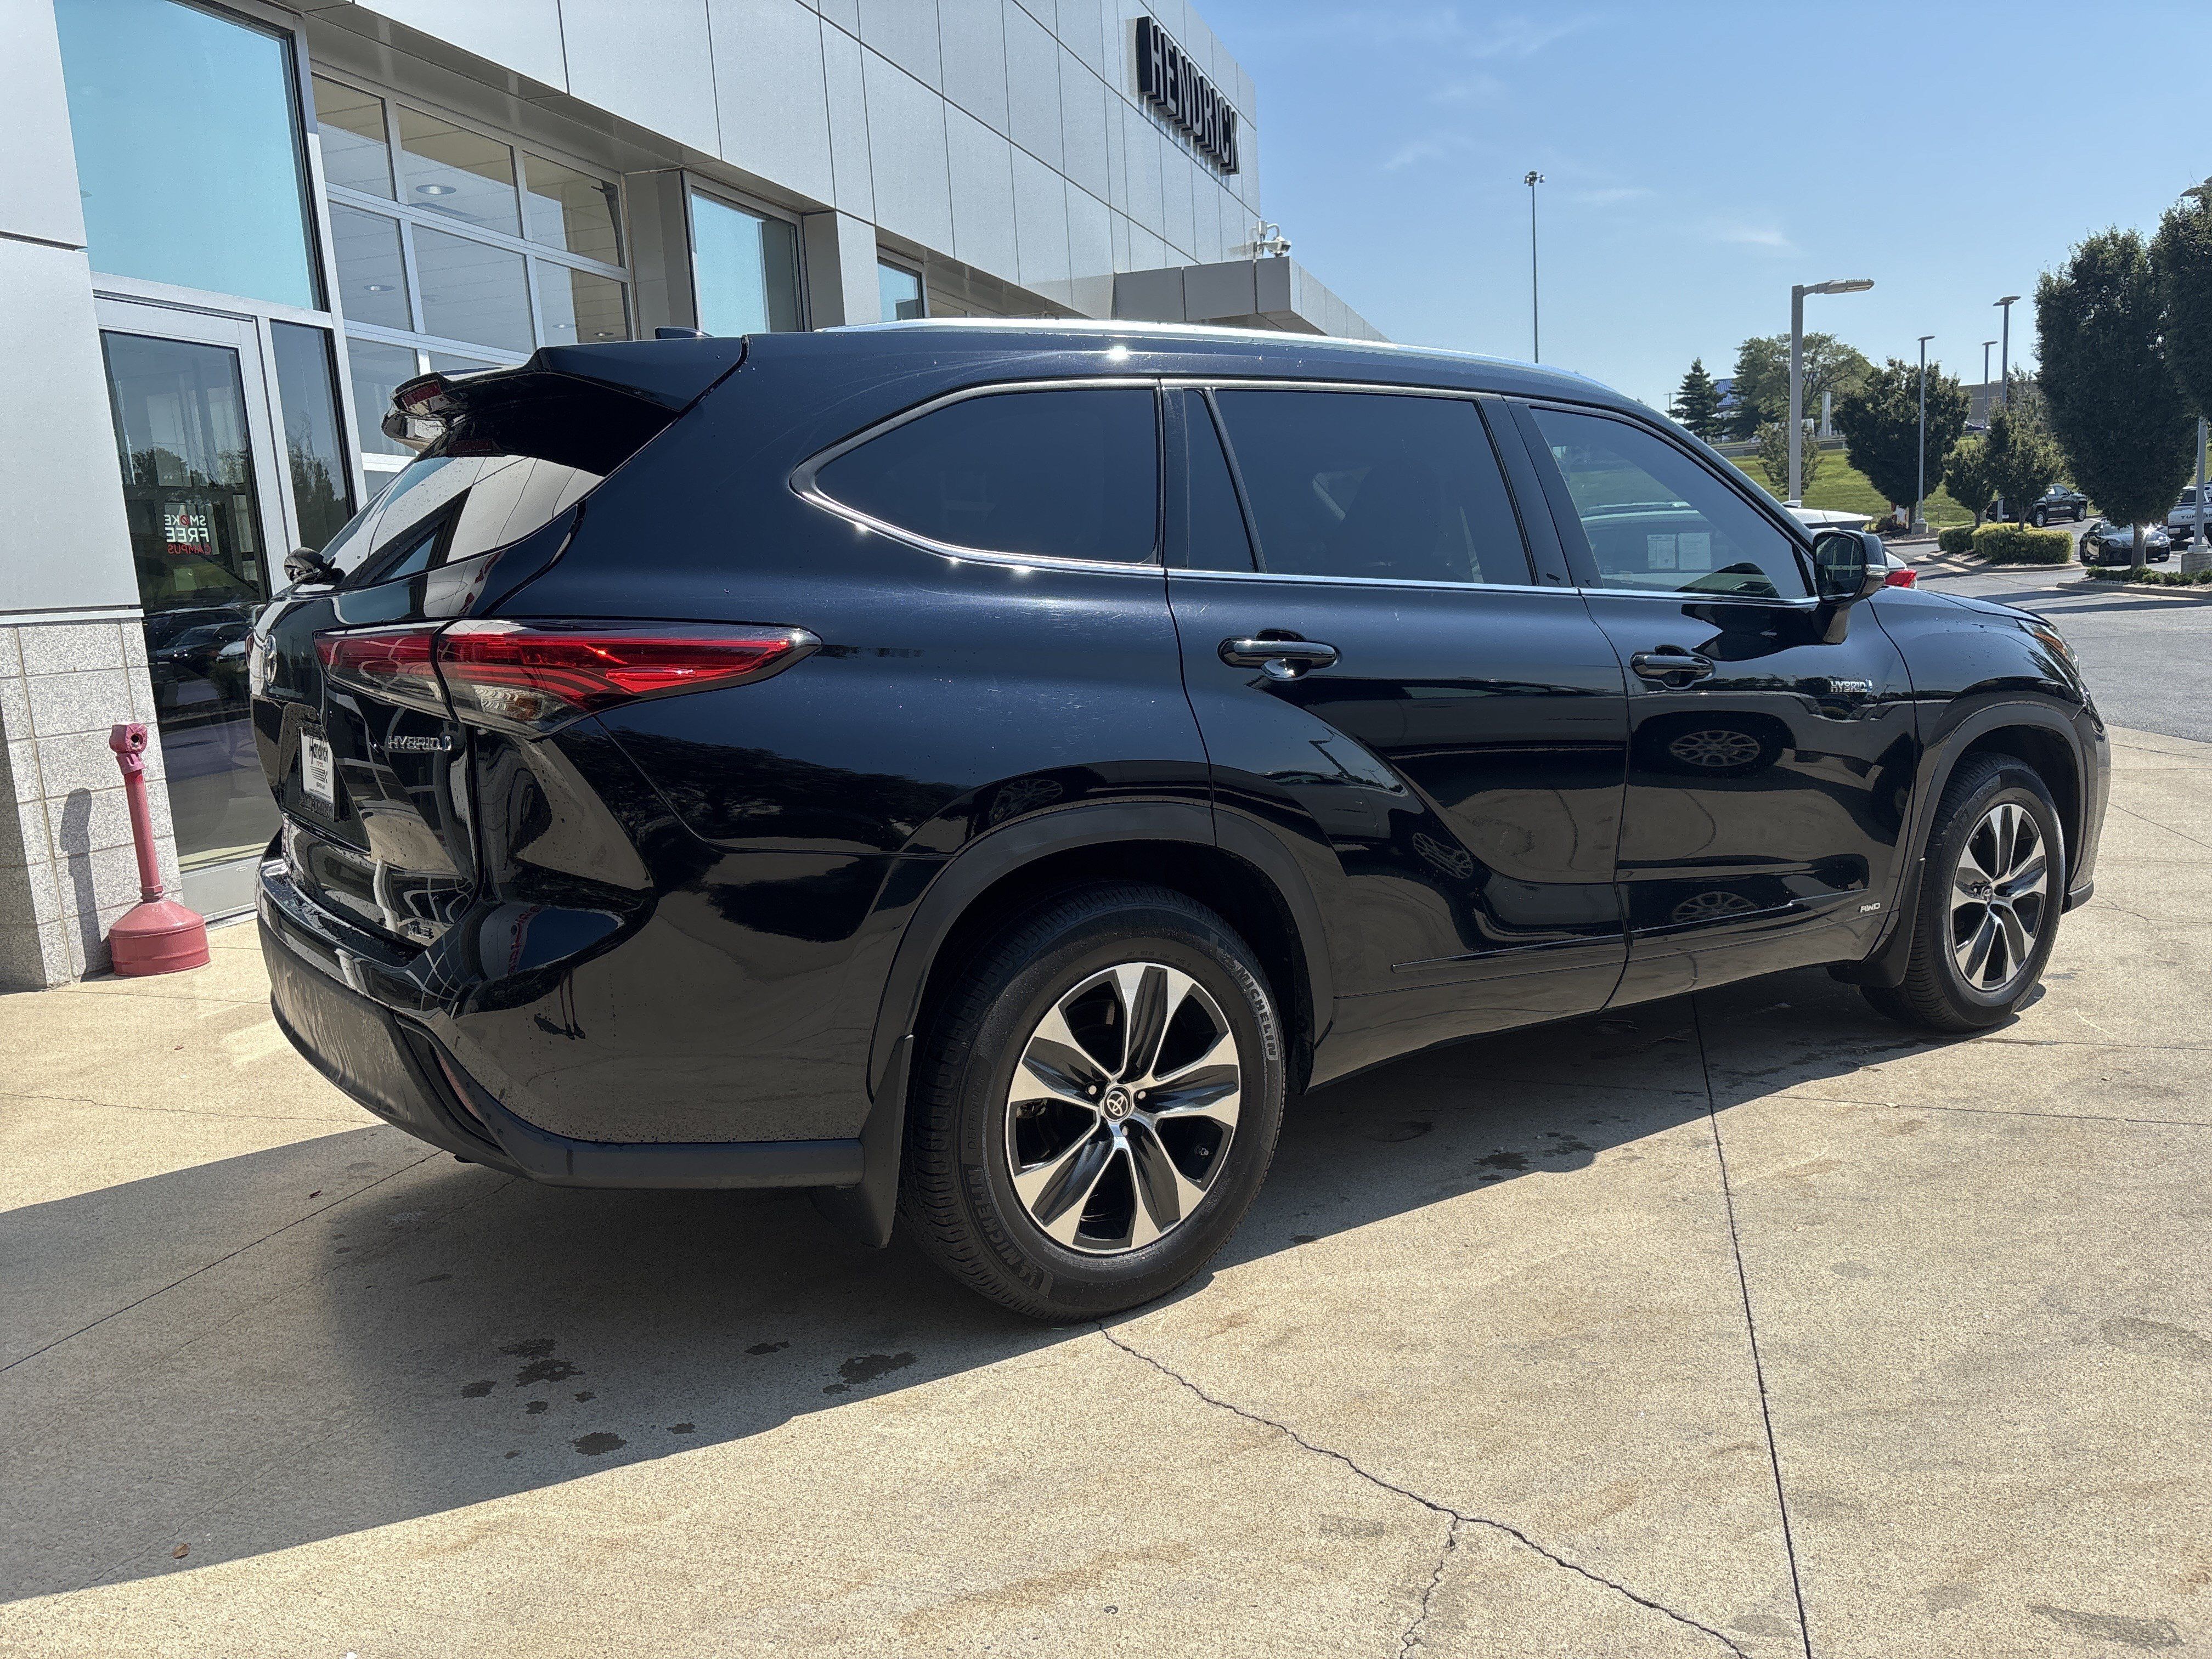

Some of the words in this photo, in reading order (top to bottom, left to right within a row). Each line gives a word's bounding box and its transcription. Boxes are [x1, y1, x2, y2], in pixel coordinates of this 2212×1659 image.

[1136, 16, 1239, 174] HENDRICK
[1830, 681, 1866, 692] HYBRID
[388, 735, 440, 751] HYBRID
[1860, 902, 1881, 913] AWD
[407, 923, 432, 939] XLE
[1235, 966, 1277, 1057] MICHELIN
[967, 1075, 985, 1152] DEFENDER
[966, 1164, 1022, 1266] MICHELIN
